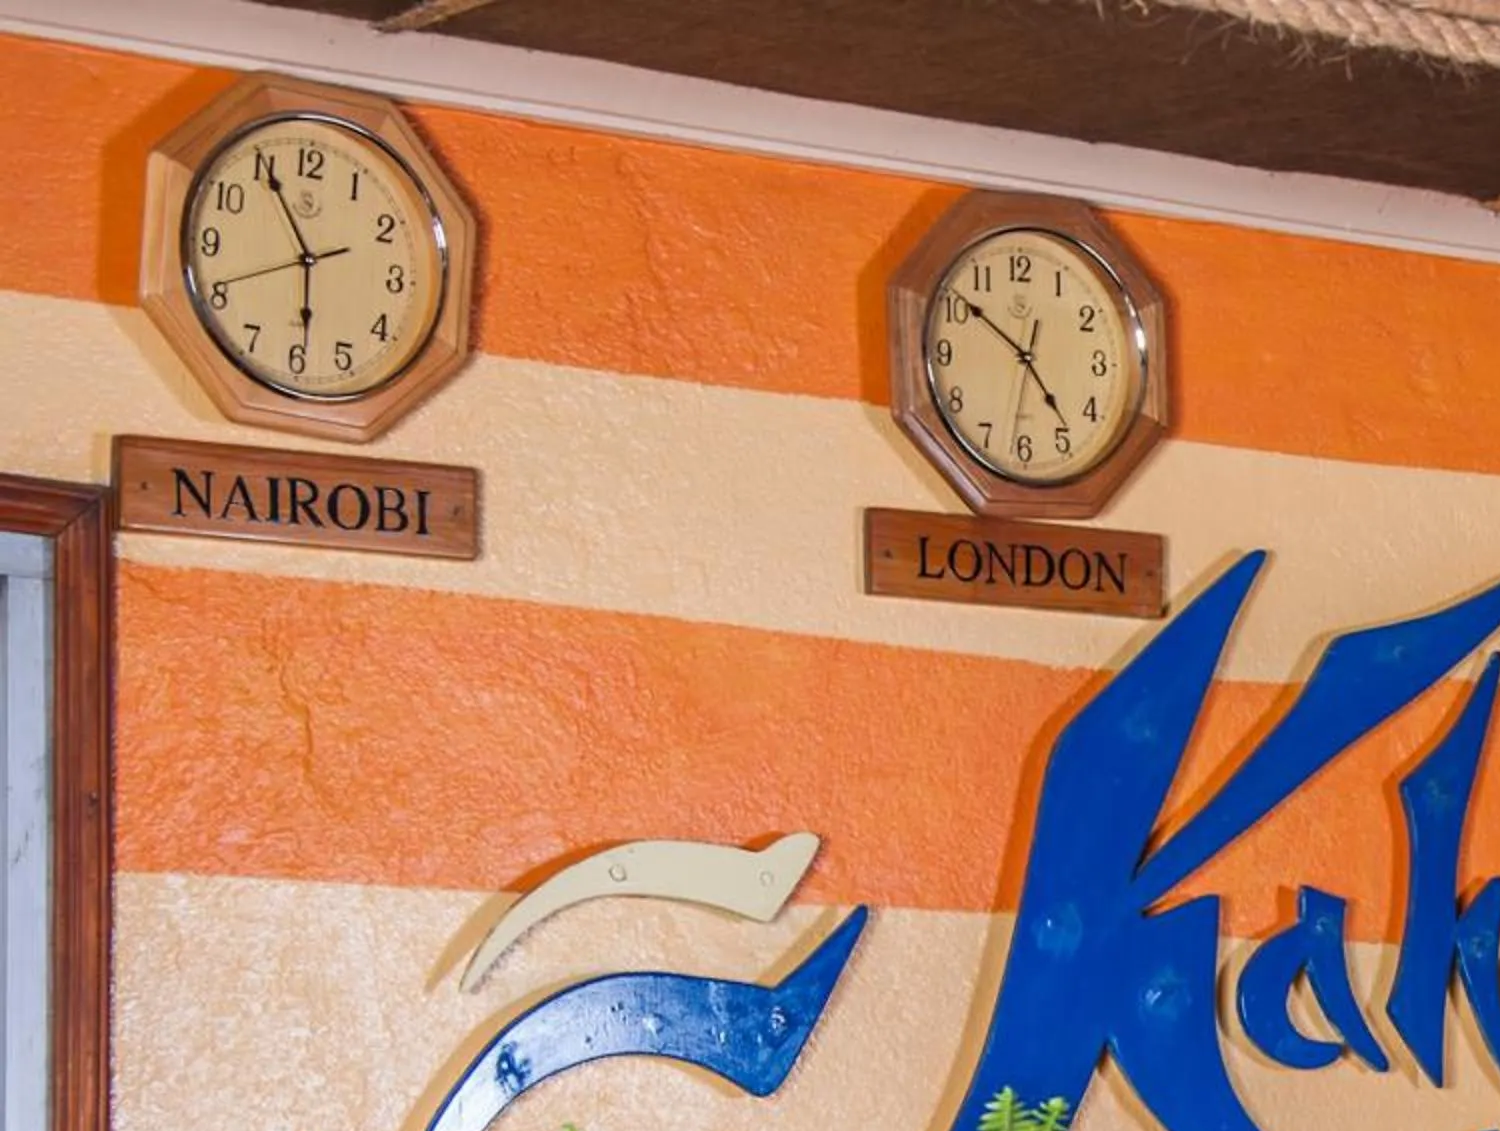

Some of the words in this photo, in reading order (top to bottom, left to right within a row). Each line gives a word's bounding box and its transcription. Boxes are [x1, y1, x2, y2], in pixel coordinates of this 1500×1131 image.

[298, 148, 324, 180] 12
[217, 183, 244, 214] 10
[348, 172, 359, 201] 1
[201, 228, 221, 256] 9
[376, 215, 396, 242] 2
[386, 265, 404, 293] 3
[973, 265, 992, 293] 11
[1009, 255, 1032, 283] 12
[211, 282, 228, 309] 8
[1055, 271, 1062, 297] 1
[945, 295, 969, 323] 10
[1079, 306, 1094, 332] 2
[244, 325, 262, 353] 7
[371, 314, 388, 341] 4
[289, 345, 306, 374] 6
[335, 343, 353, 370] 5
[937, 340, 951, 365] 9
[1092, 351, 1107, 376] 3
[949, 387, 963, 413] 8
[1083, 397, 1097, 422] 4
[978, 423, 992, 449] 7
[1017, 436, 1032, 463] 6
[1055, 428, 1071, 453] 5
[171, 467, 431, 535] NAIROBI
[917, 536, 1127, 594] LONDON
